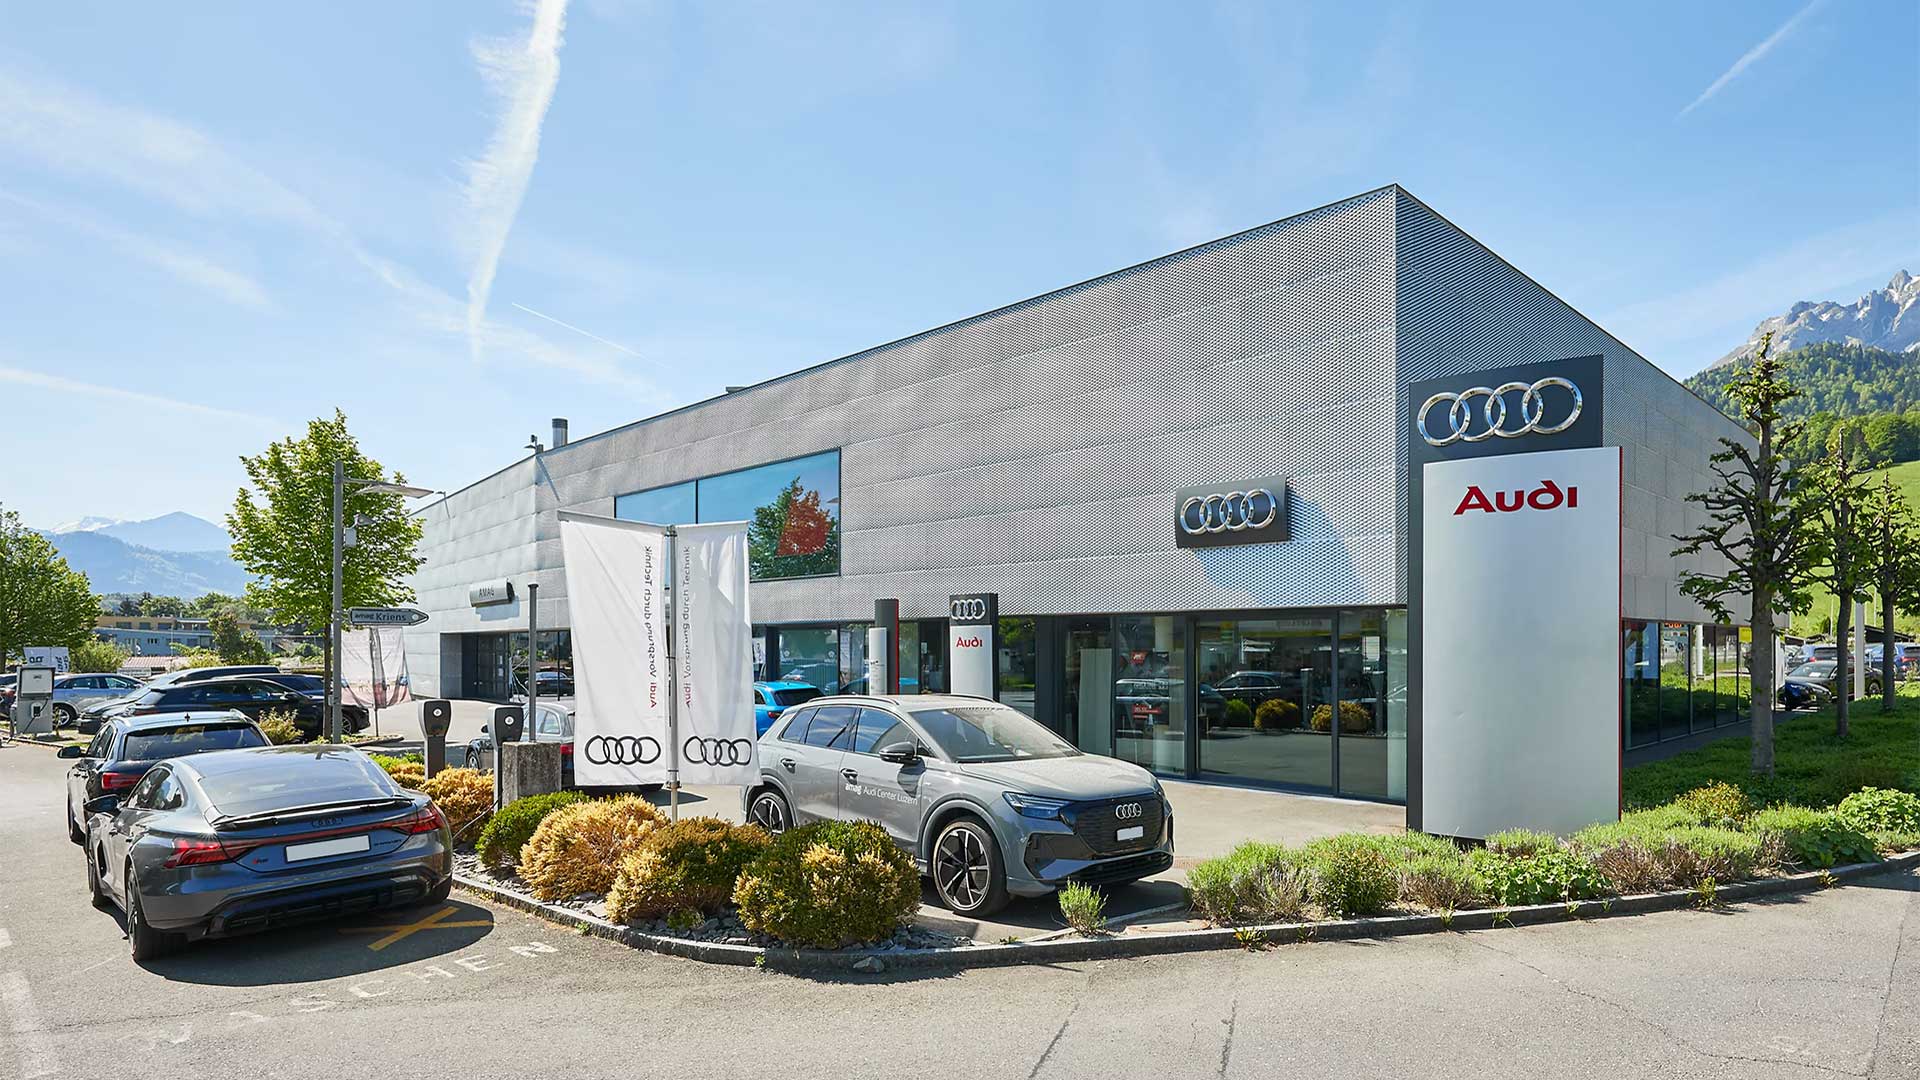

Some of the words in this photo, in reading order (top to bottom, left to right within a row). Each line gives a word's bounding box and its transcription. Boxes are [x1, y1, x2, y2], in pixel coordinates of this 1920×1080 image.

[1453, 480, 1578, 515] Audi
[682, 546, 690, 587] Technik
[682, 589, 690, 620] durch
[376, 612, 407, 622] Kriens
[956, 636, 983, 648] Audi
[845, 784, 862, 796] amag
[863, 786, 877, 796] Audi
[877, 789, 897, 800] Center
